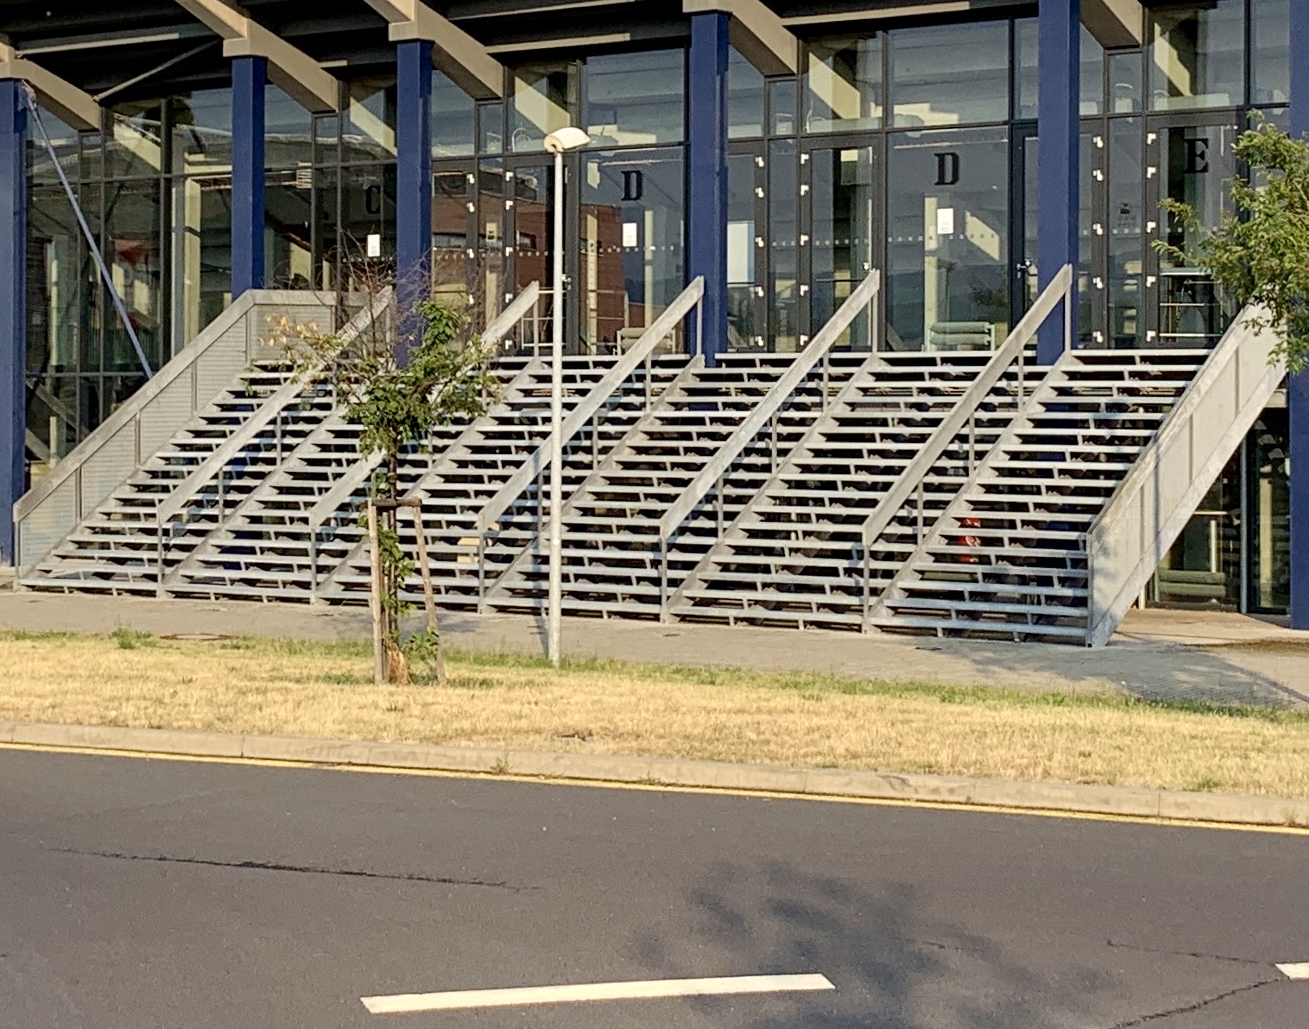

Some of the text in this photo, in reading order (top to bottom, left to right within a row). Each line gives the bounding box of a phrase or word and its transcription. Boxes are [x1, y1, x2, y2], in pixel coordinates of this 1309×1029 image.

[934, 152, 959, 185] D
[1183, 138, 1209, 174] E
[621, 170, 643, 201] D
